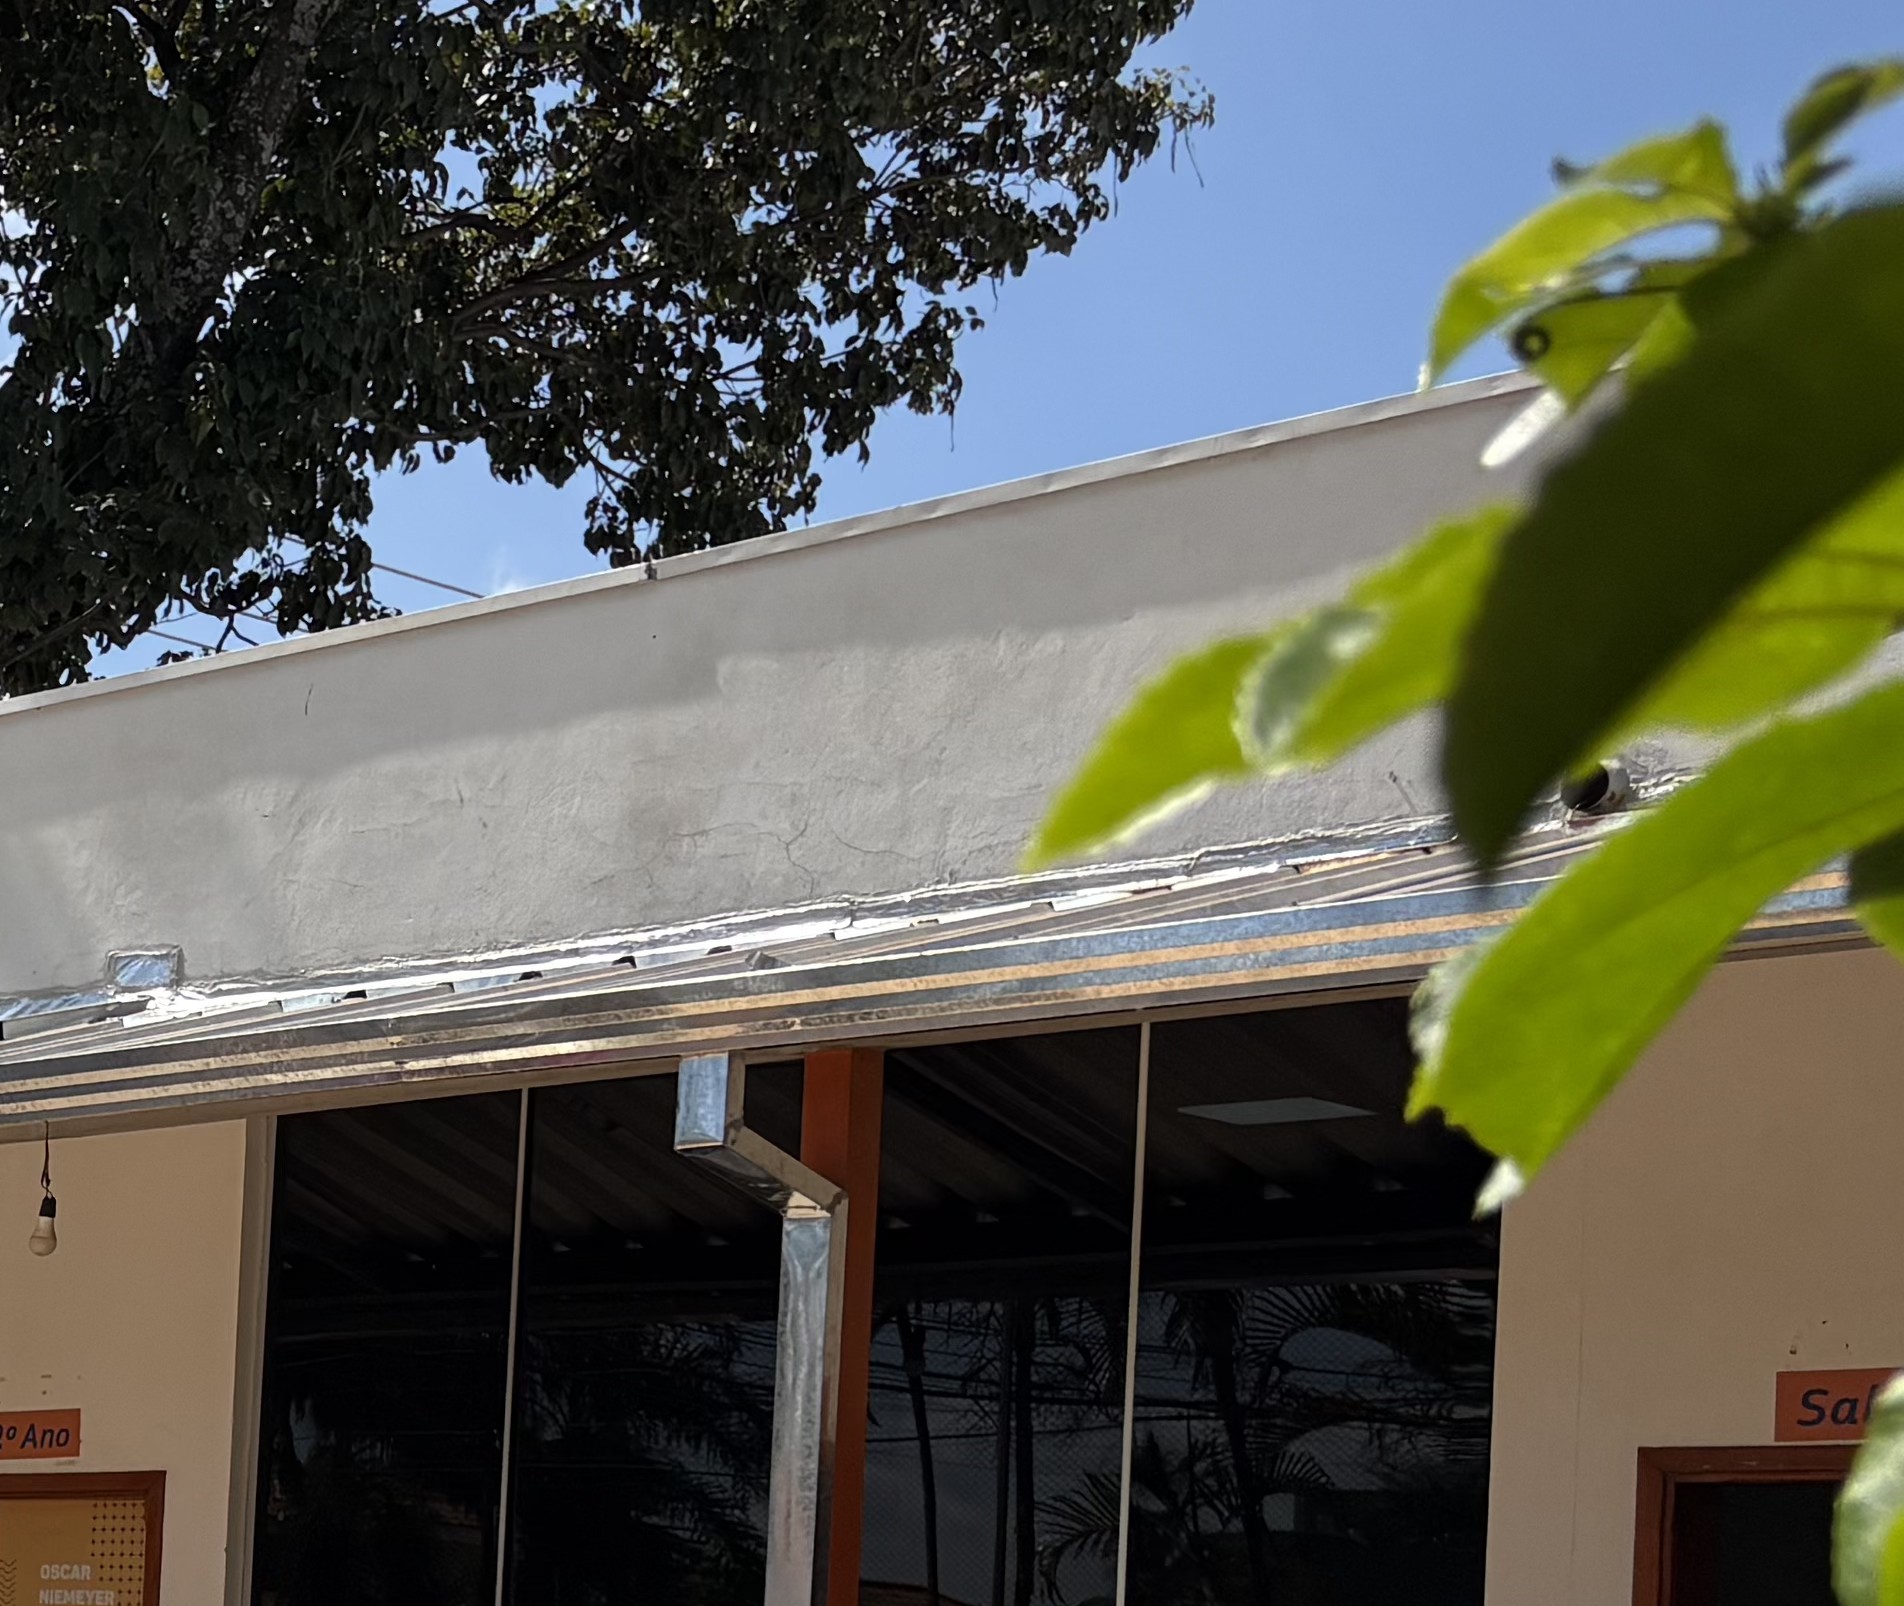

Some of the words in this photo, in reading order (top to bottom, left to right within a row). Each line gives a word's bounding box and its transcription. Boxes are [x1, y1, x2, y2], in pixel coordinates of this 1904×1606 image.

[1796, 1384, 1878, 1427] Sal
[19, 1422, 70, 1450] Ano
[40, 1564, 91, 1581] OSCAR
[38, 1589, 115, 1606] NIEMEYER
